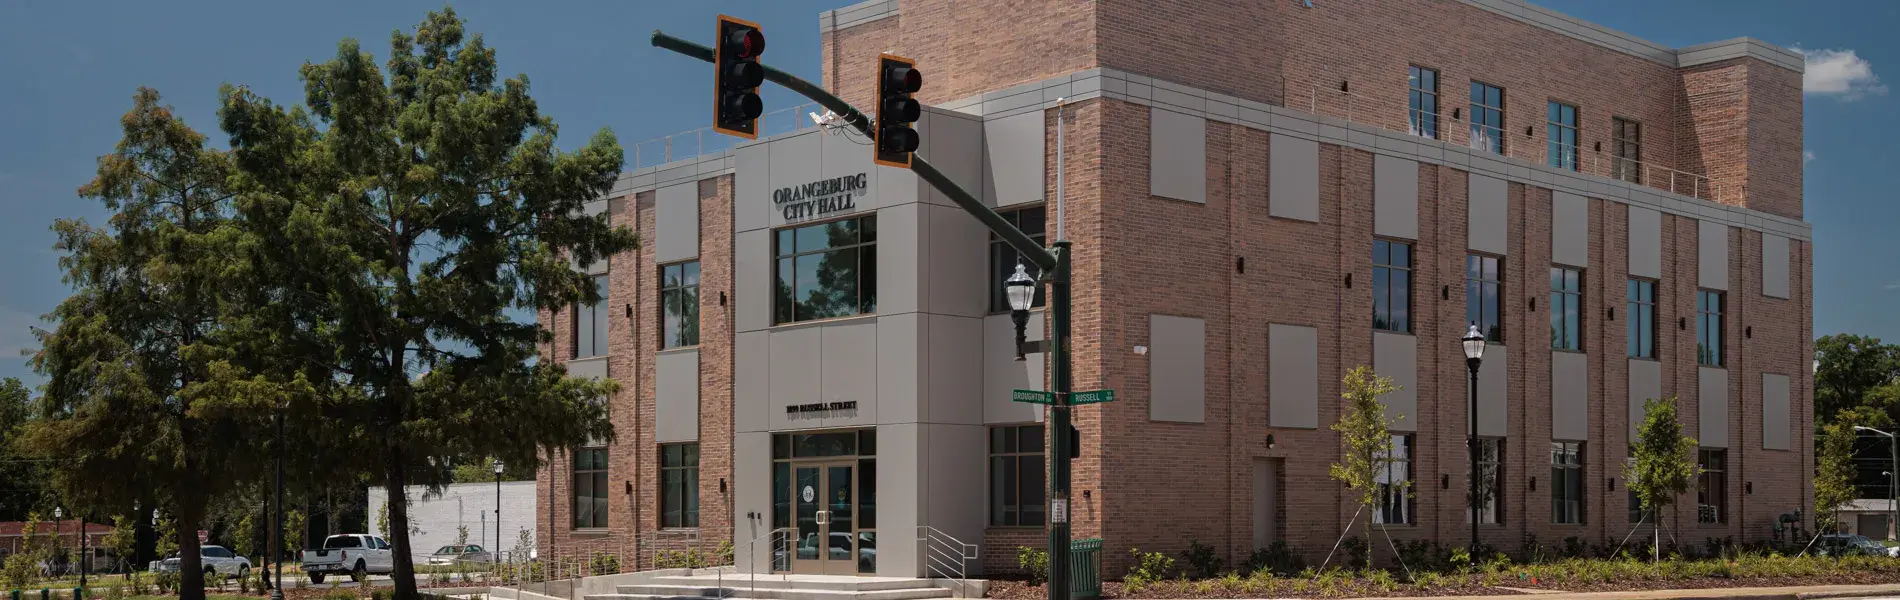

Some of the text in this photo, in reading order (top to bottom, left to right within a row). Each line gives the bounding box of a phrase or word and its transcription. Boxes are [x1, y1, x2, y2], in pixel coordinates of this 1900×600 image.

[773, 172, 867, 204] ORANGEBURG
[783, 193, 855, 220] CITY HALL
[1013, 391, 1045, 402] BROUGHTON
[1075, 392, 1100, 402] RUSSELL
[829, 401, 857, 410] STREET
